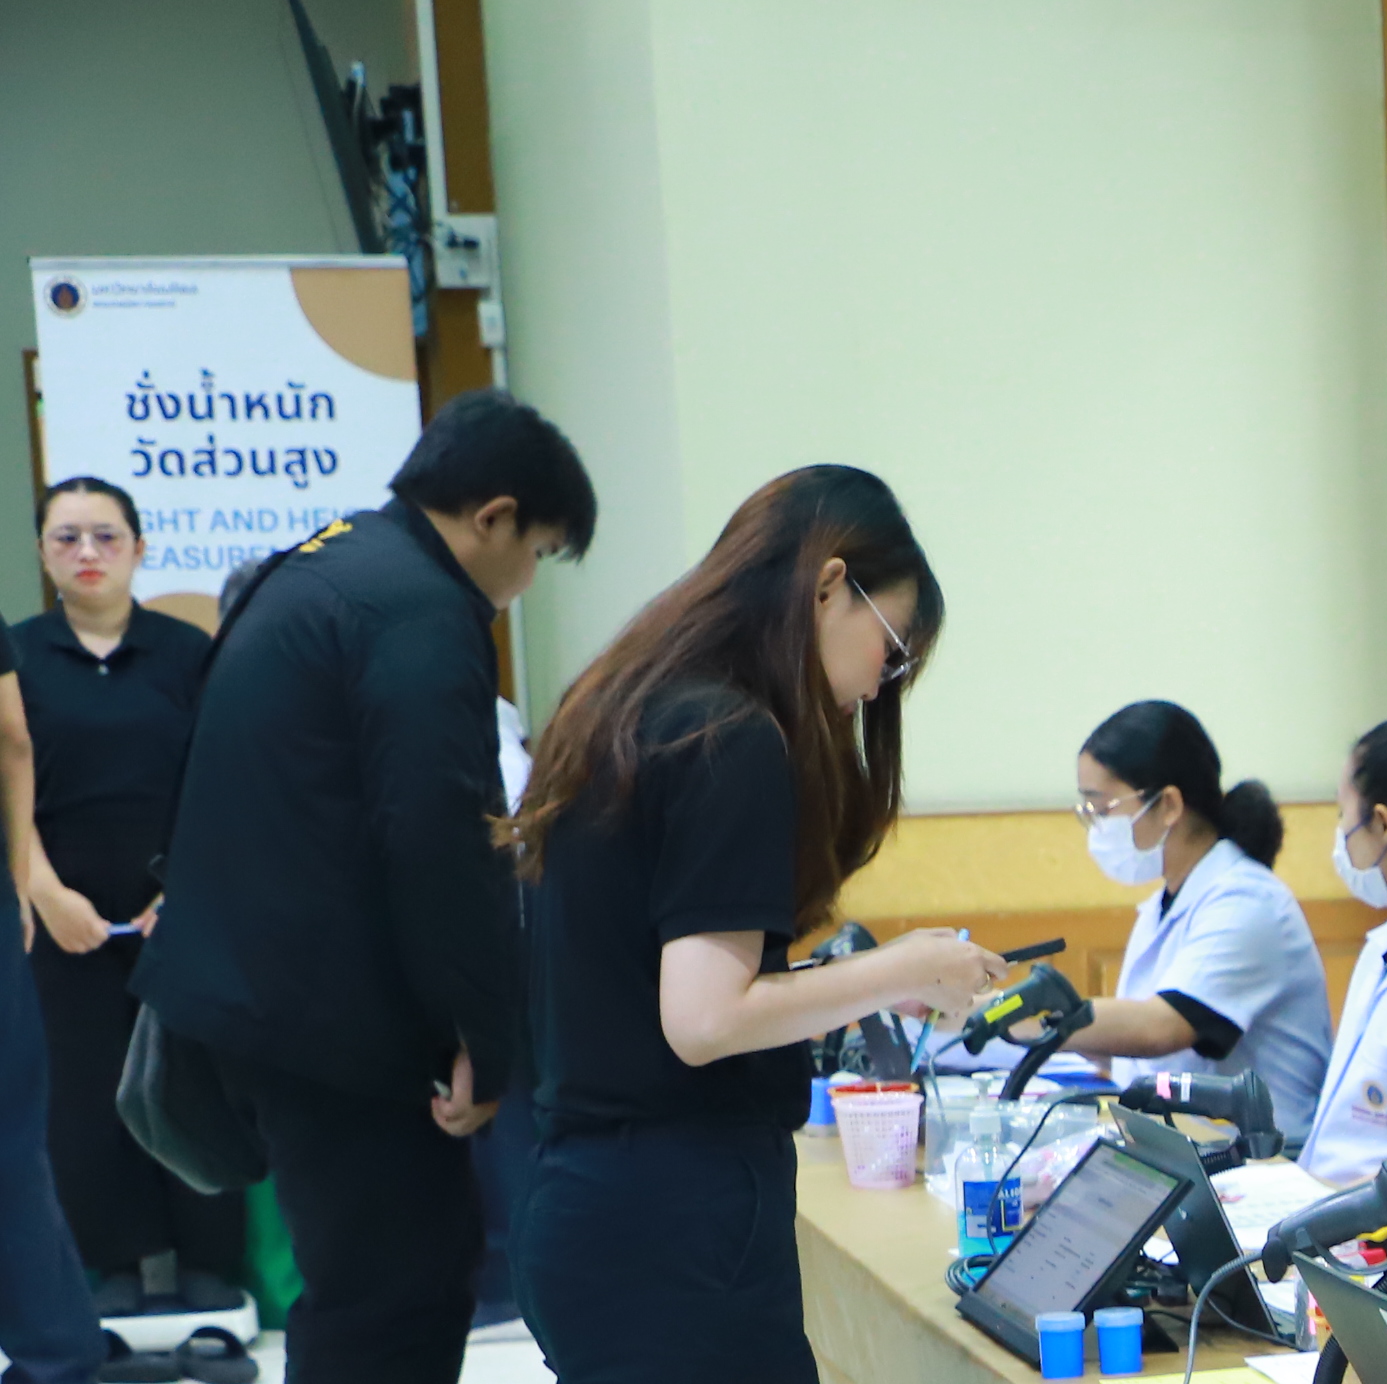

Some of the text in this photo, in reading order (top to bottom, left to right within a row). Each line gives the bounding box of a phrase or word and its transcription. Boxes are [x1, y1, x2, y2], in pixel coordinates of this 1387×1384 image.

[125, 368, 336, 422] ชั่งน้ำหนัก
[130, 432, 339, 489] วัดส่วนสูง
[140, 508, 201, 532] GHT
[208, 508, 279, 532] AND
